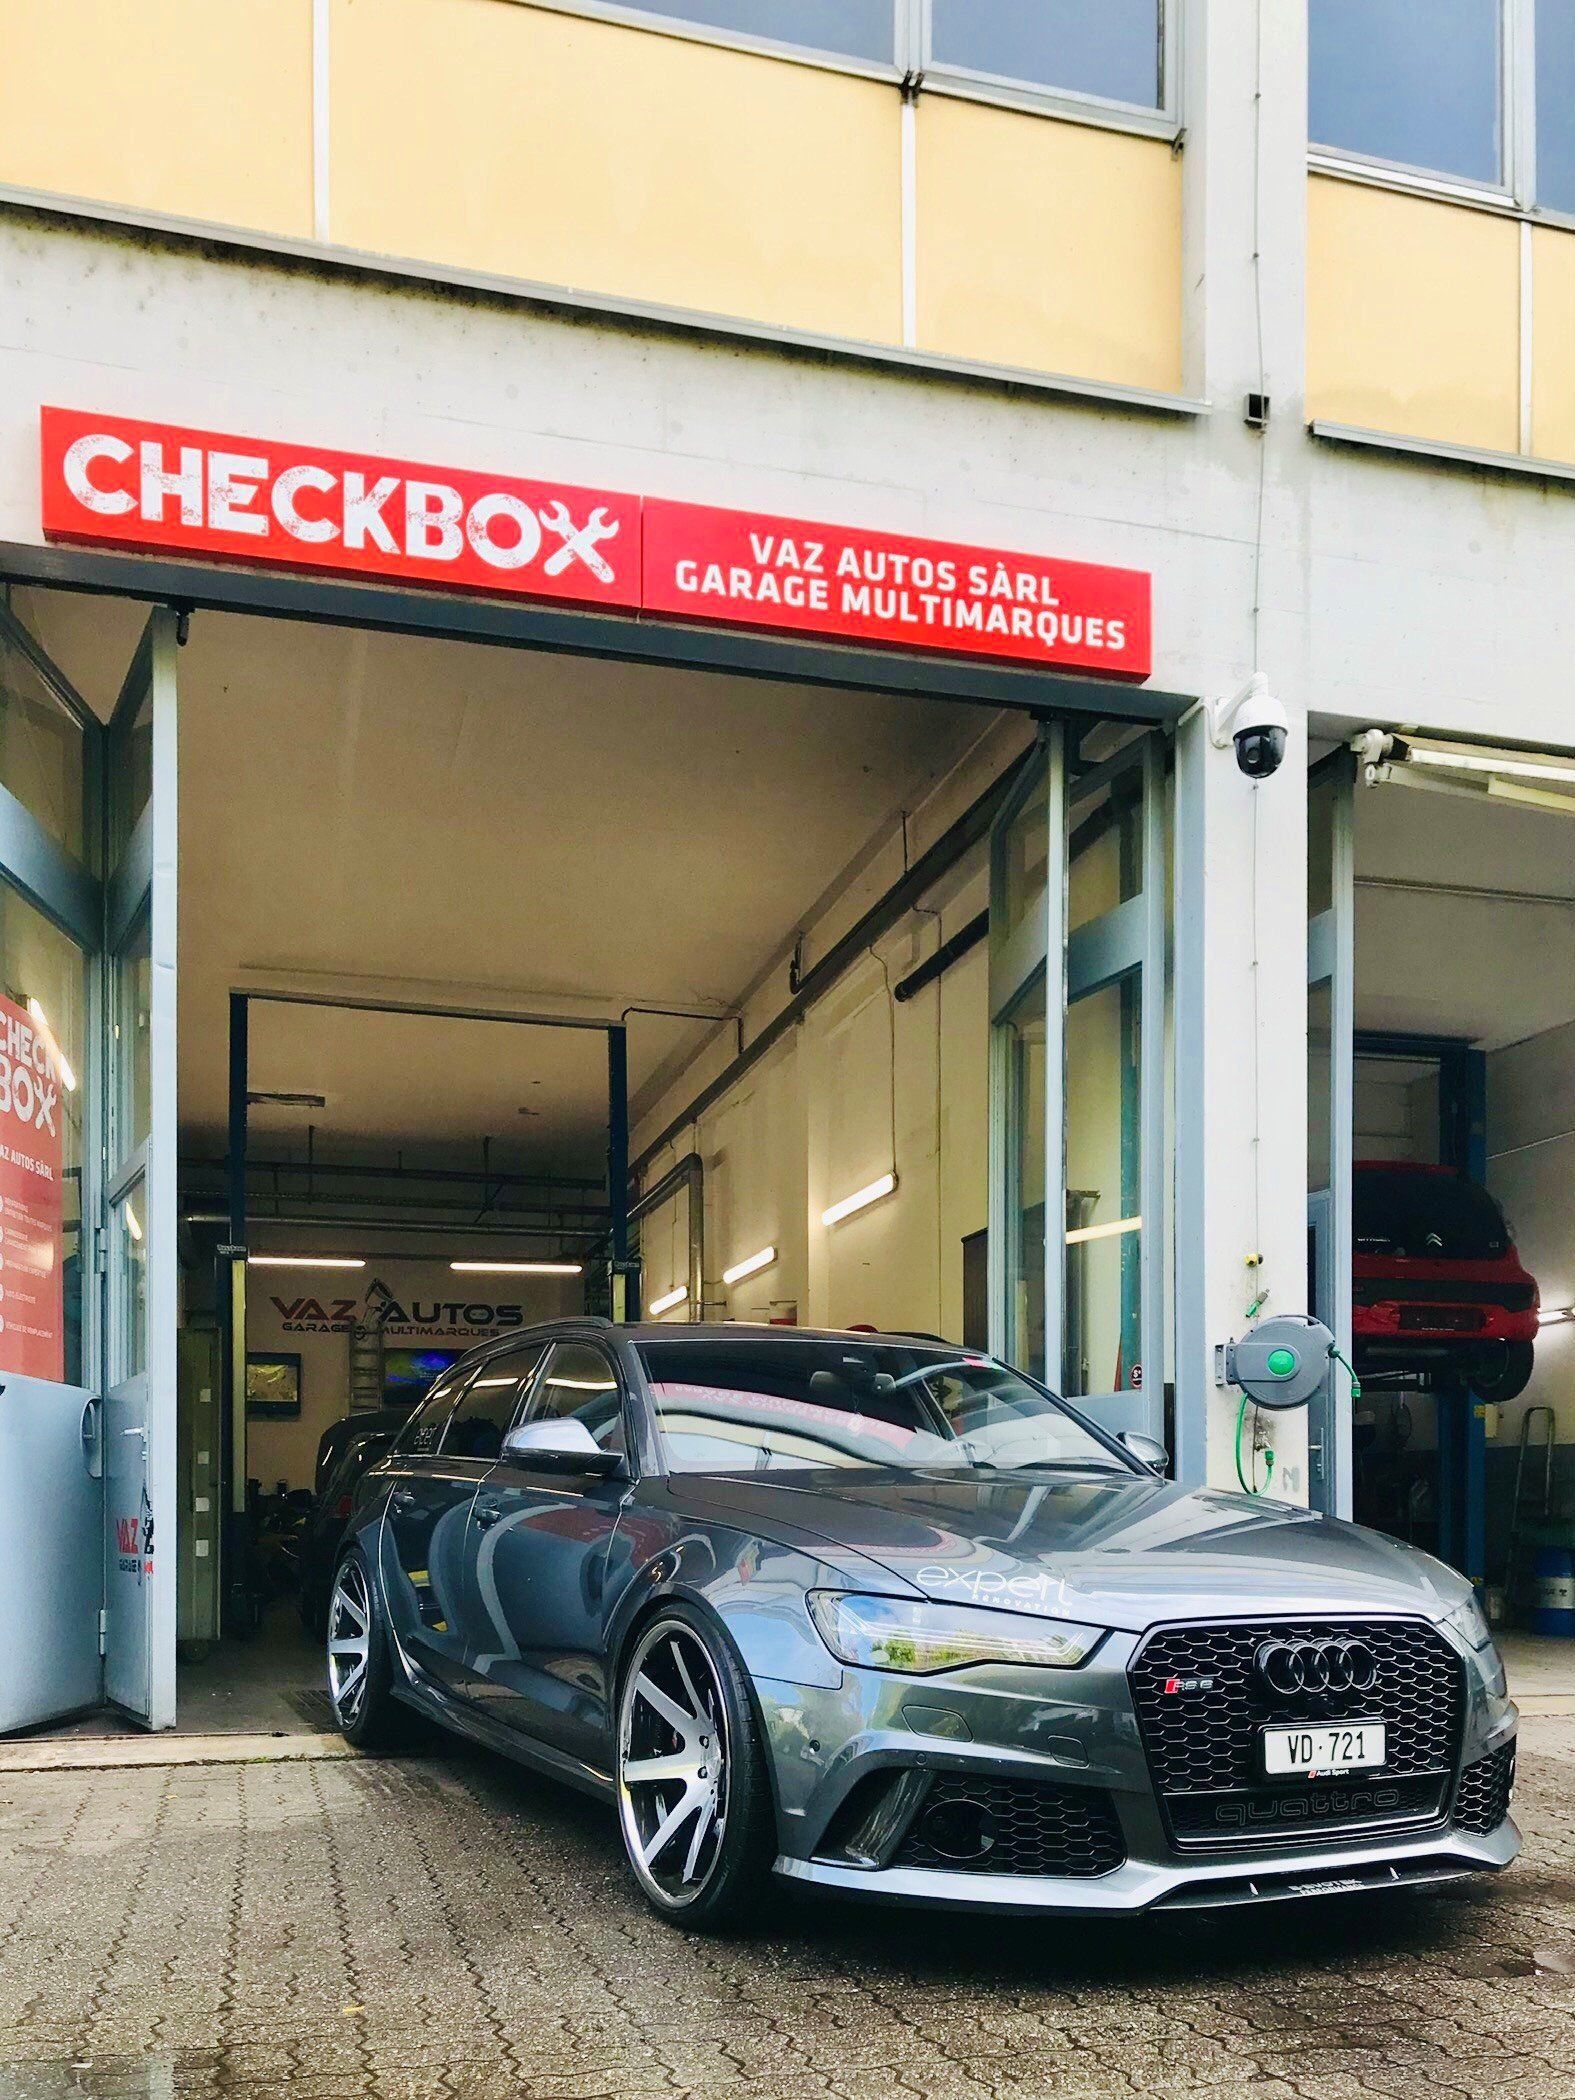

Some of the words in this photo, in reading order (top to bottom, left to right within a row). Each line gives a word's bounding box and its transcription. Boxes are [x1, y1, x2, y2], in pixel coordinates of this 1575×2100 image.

[750, 534, 823, 573] VAZ
[837, 548, 955, 592] AUTOS
[970, 562, 1058, 606] SÀRL
[676, 560, 827, 610] GARAGE
[842, 584, 1124, 649] MULTIMARQUES
[11, 1149, 35, 1173] AUTOS
[269, 1297, 356, 1320] VAZ
[379, 1301, 523, 1326] AUTOS
[282, 1323, 350, 1333] GARAGE
[1216, 1789, 1399, 1826] quattro
